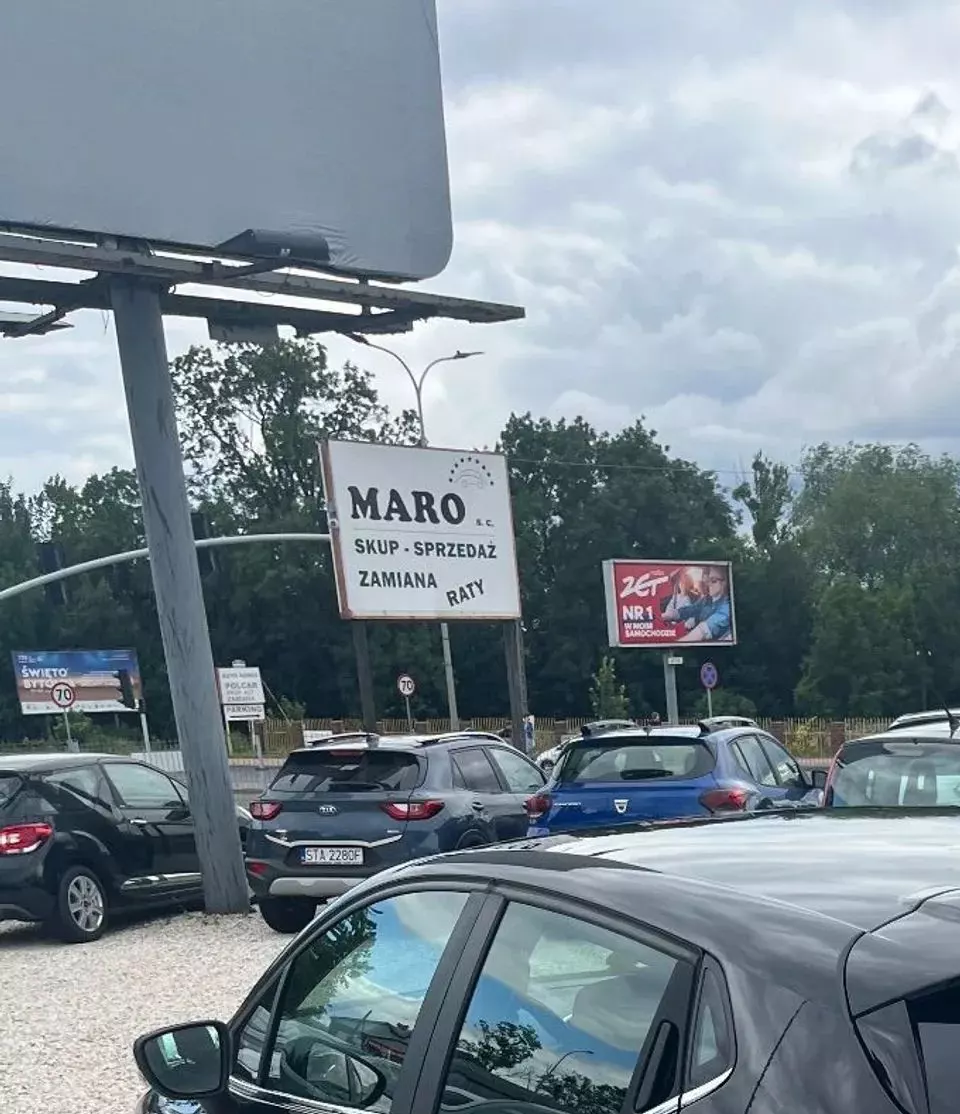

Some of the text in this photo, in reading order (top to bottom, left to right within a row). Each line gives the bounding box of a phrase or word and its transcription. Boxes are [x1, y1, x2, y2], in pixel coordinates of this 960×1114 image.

[348, 486, 465, 525] MARO
[354, 538, 399, 555] SKUP
[414, 540, 497, 559] SPRZEDAŻ
[358, 570, 437, 589] ZAMIANA
[446, 579, 484, 607] RATY
[622, 606, 653, 620] NR 1
[401, 680, 413, 691] 70
[55, 689, 71, 701] 70
[306, 849, 326, 861] STA
